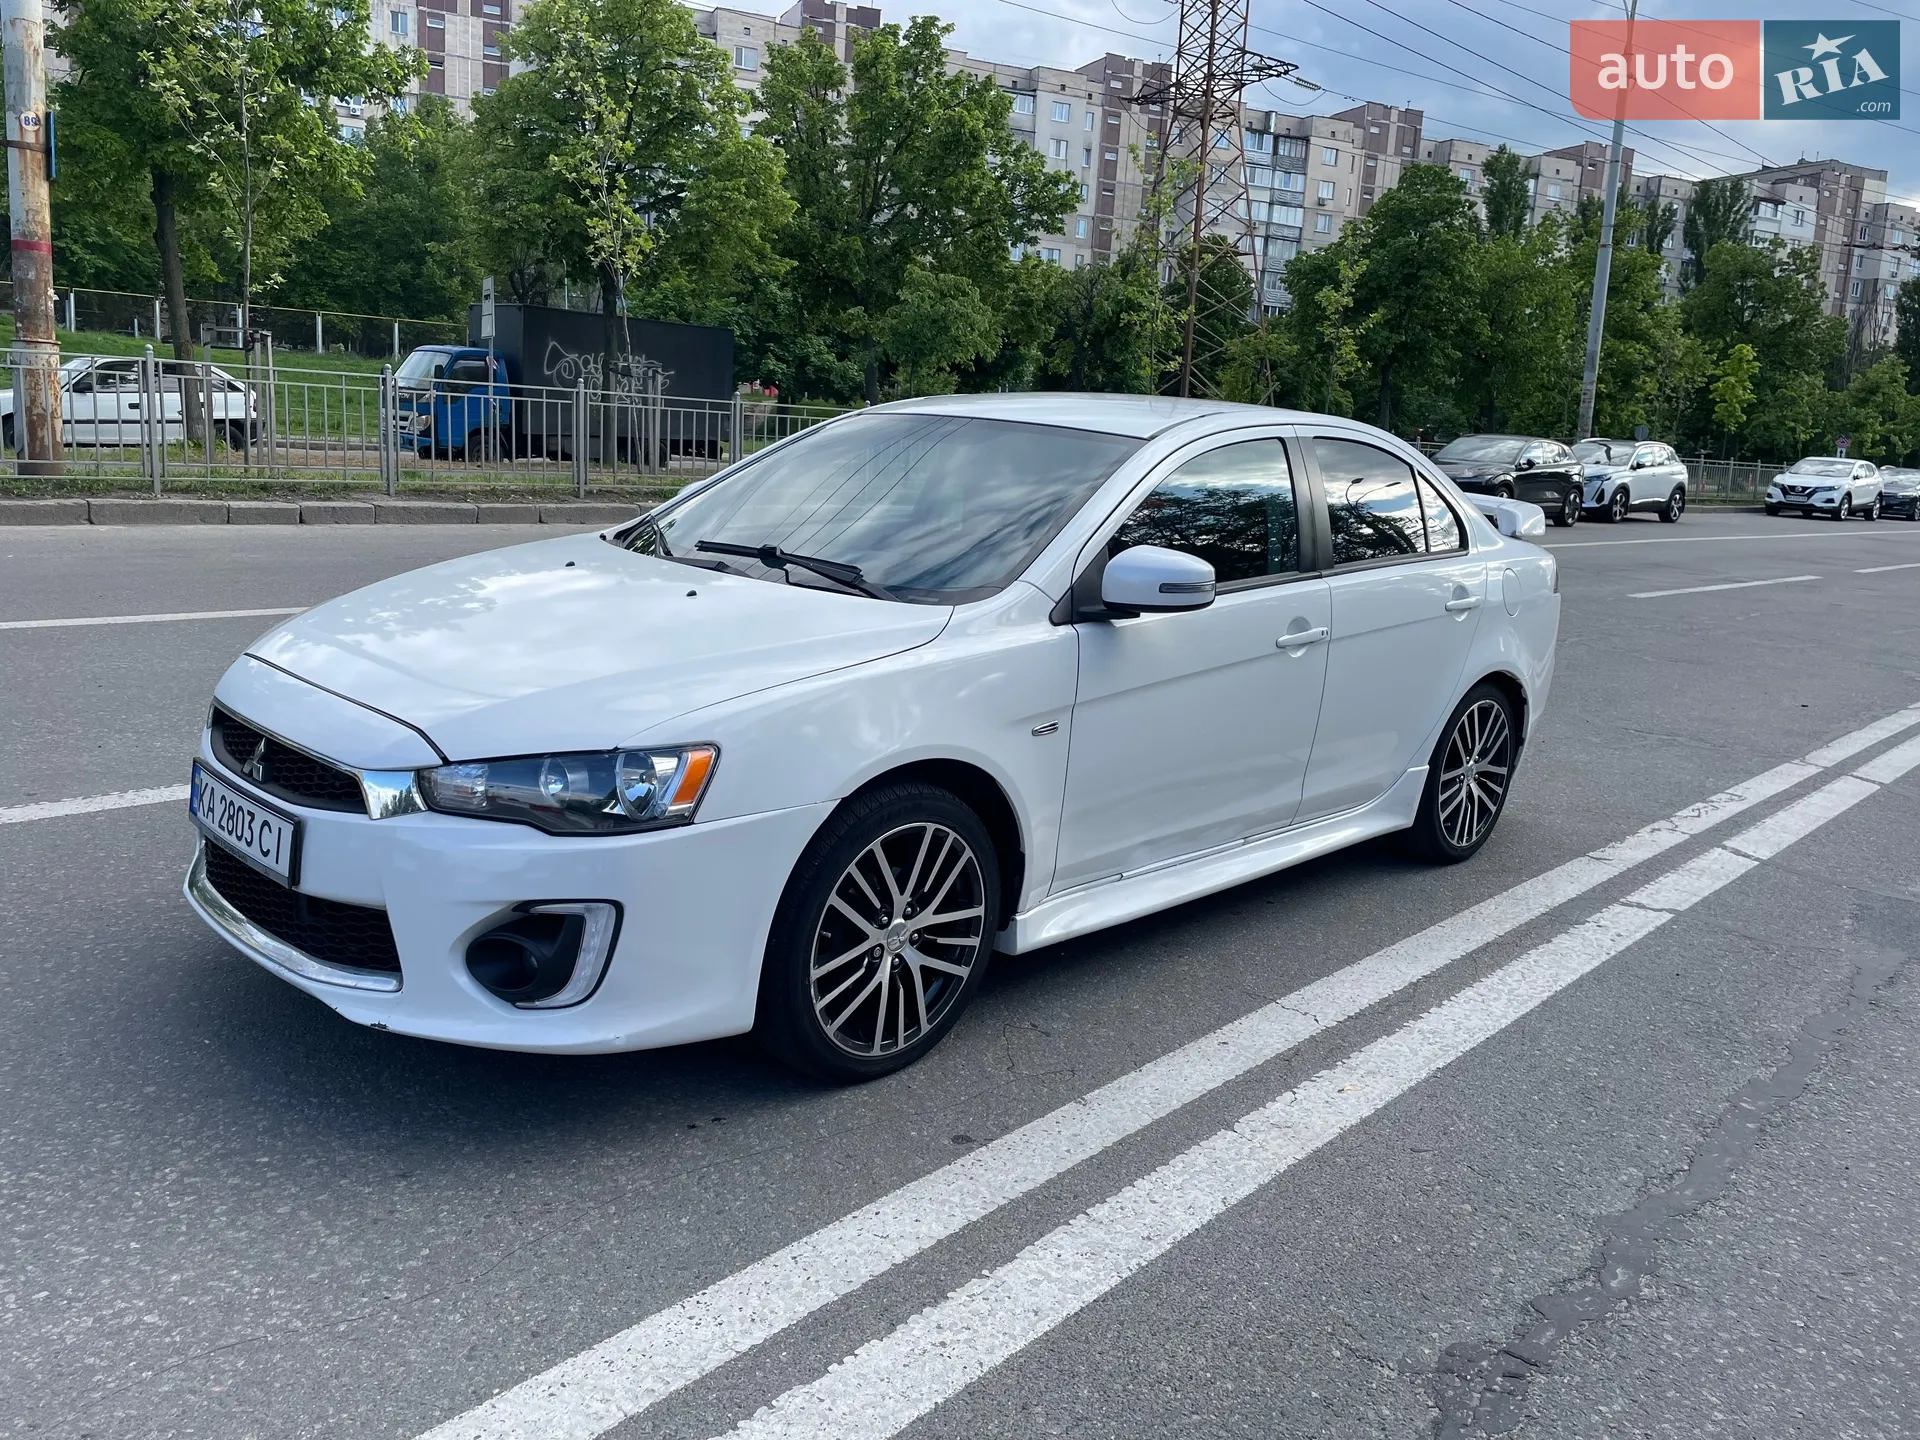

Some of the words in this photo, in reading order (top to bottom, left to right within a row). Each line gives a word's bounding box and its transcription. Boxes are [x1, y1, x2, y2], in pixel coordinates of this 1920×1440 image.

[23, 115, 38, 126] 89
[199, 778, 215, 824] KA
[218, 794, 255, 847] 2803
[258, 819, 282, 865] CI
